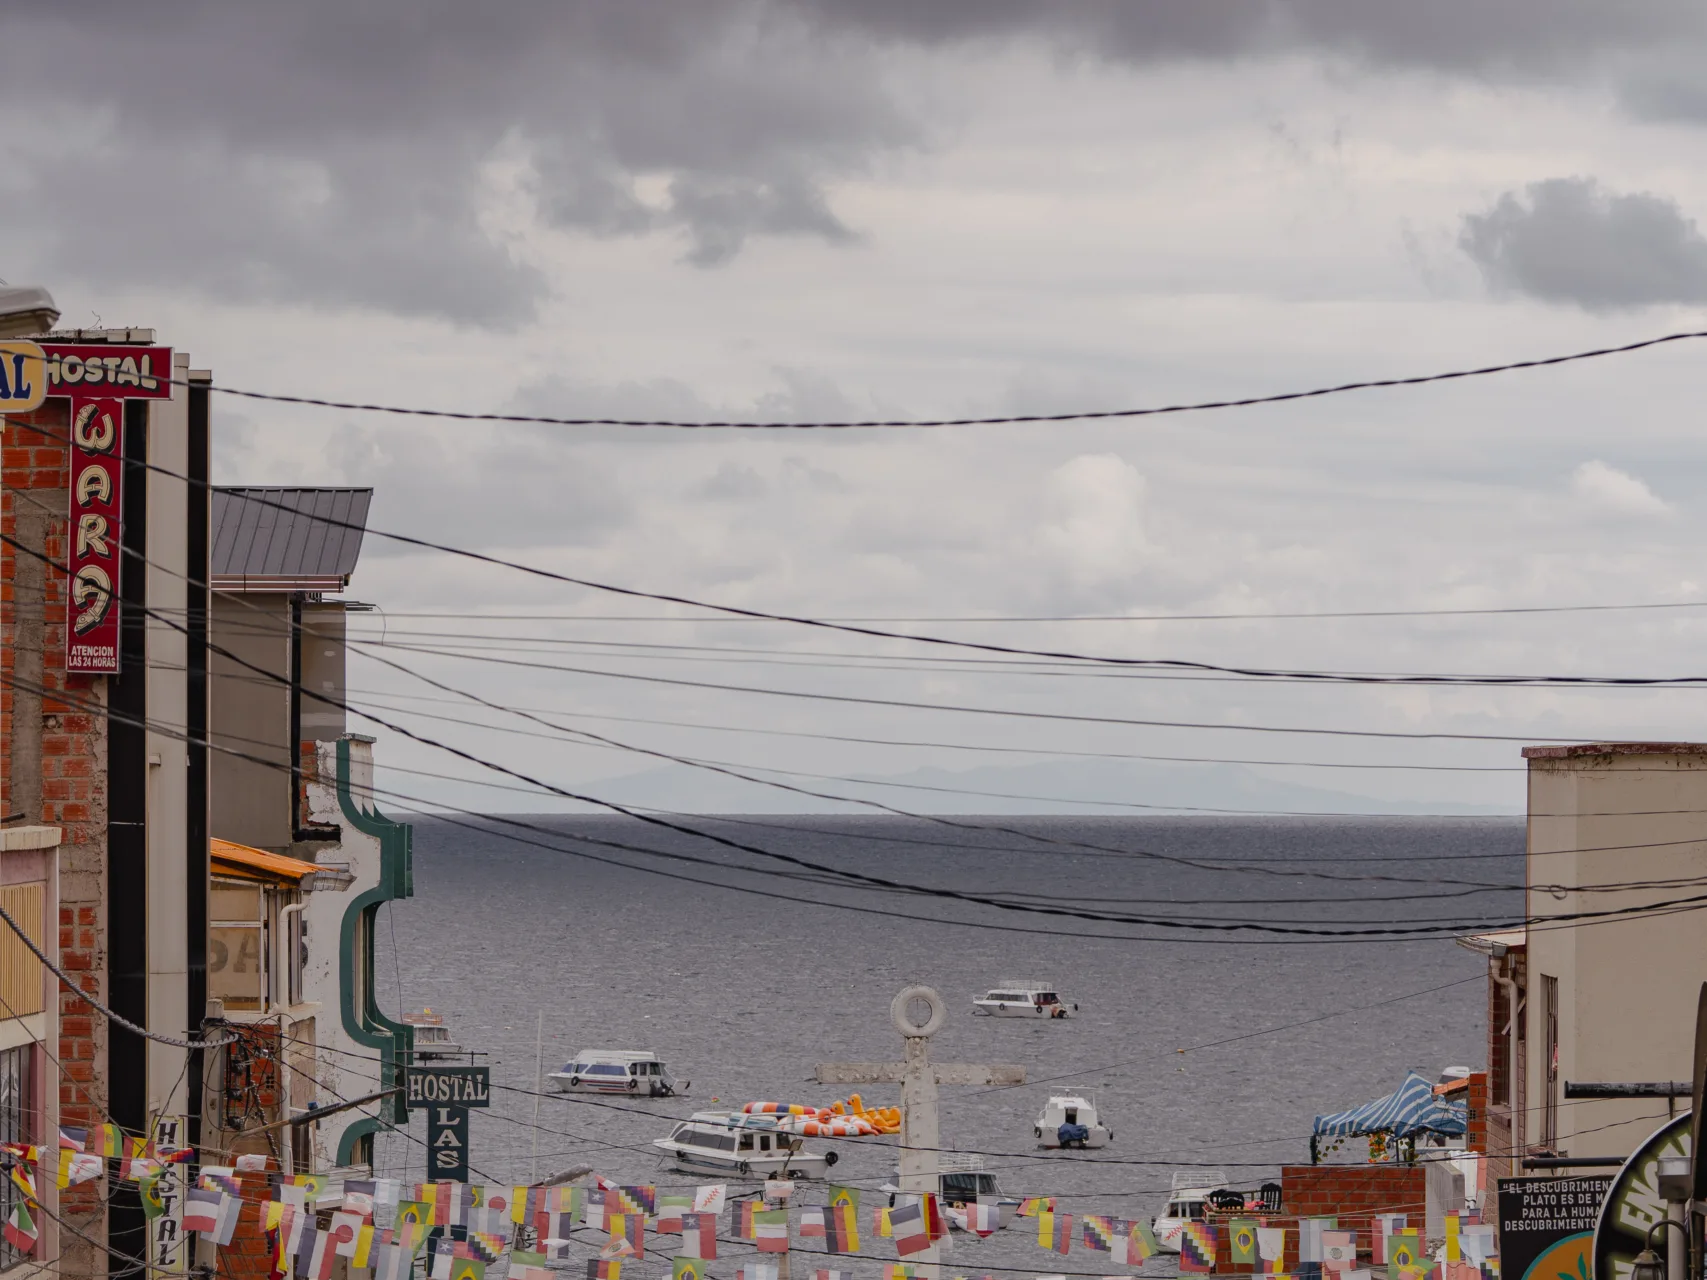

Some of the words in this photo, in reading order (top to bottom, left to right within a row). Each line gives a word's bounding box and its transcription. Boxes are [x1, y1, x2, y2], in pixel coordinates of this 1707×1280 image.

[47, 352, 158, 390] HOSTAL
[74, 403, 116, 638] WARA
[71, 645, 114, 657] ATENCION
[69, 656, 82, 667] LAS
[83, 657, 92, 667] 24
[92, 657, 116, 668] HORAS
[409, 1074, 489, 1102] HOSTAL
[1523, 1195, 1557, 1206] PLATO
[1561, 1194, 1574, 1205] ES
[1578, 1193, 1592, 1204] DE
[1522, 1207, 1549, 1219] PARA
[1554, 1207, 1567, 1218] LA
